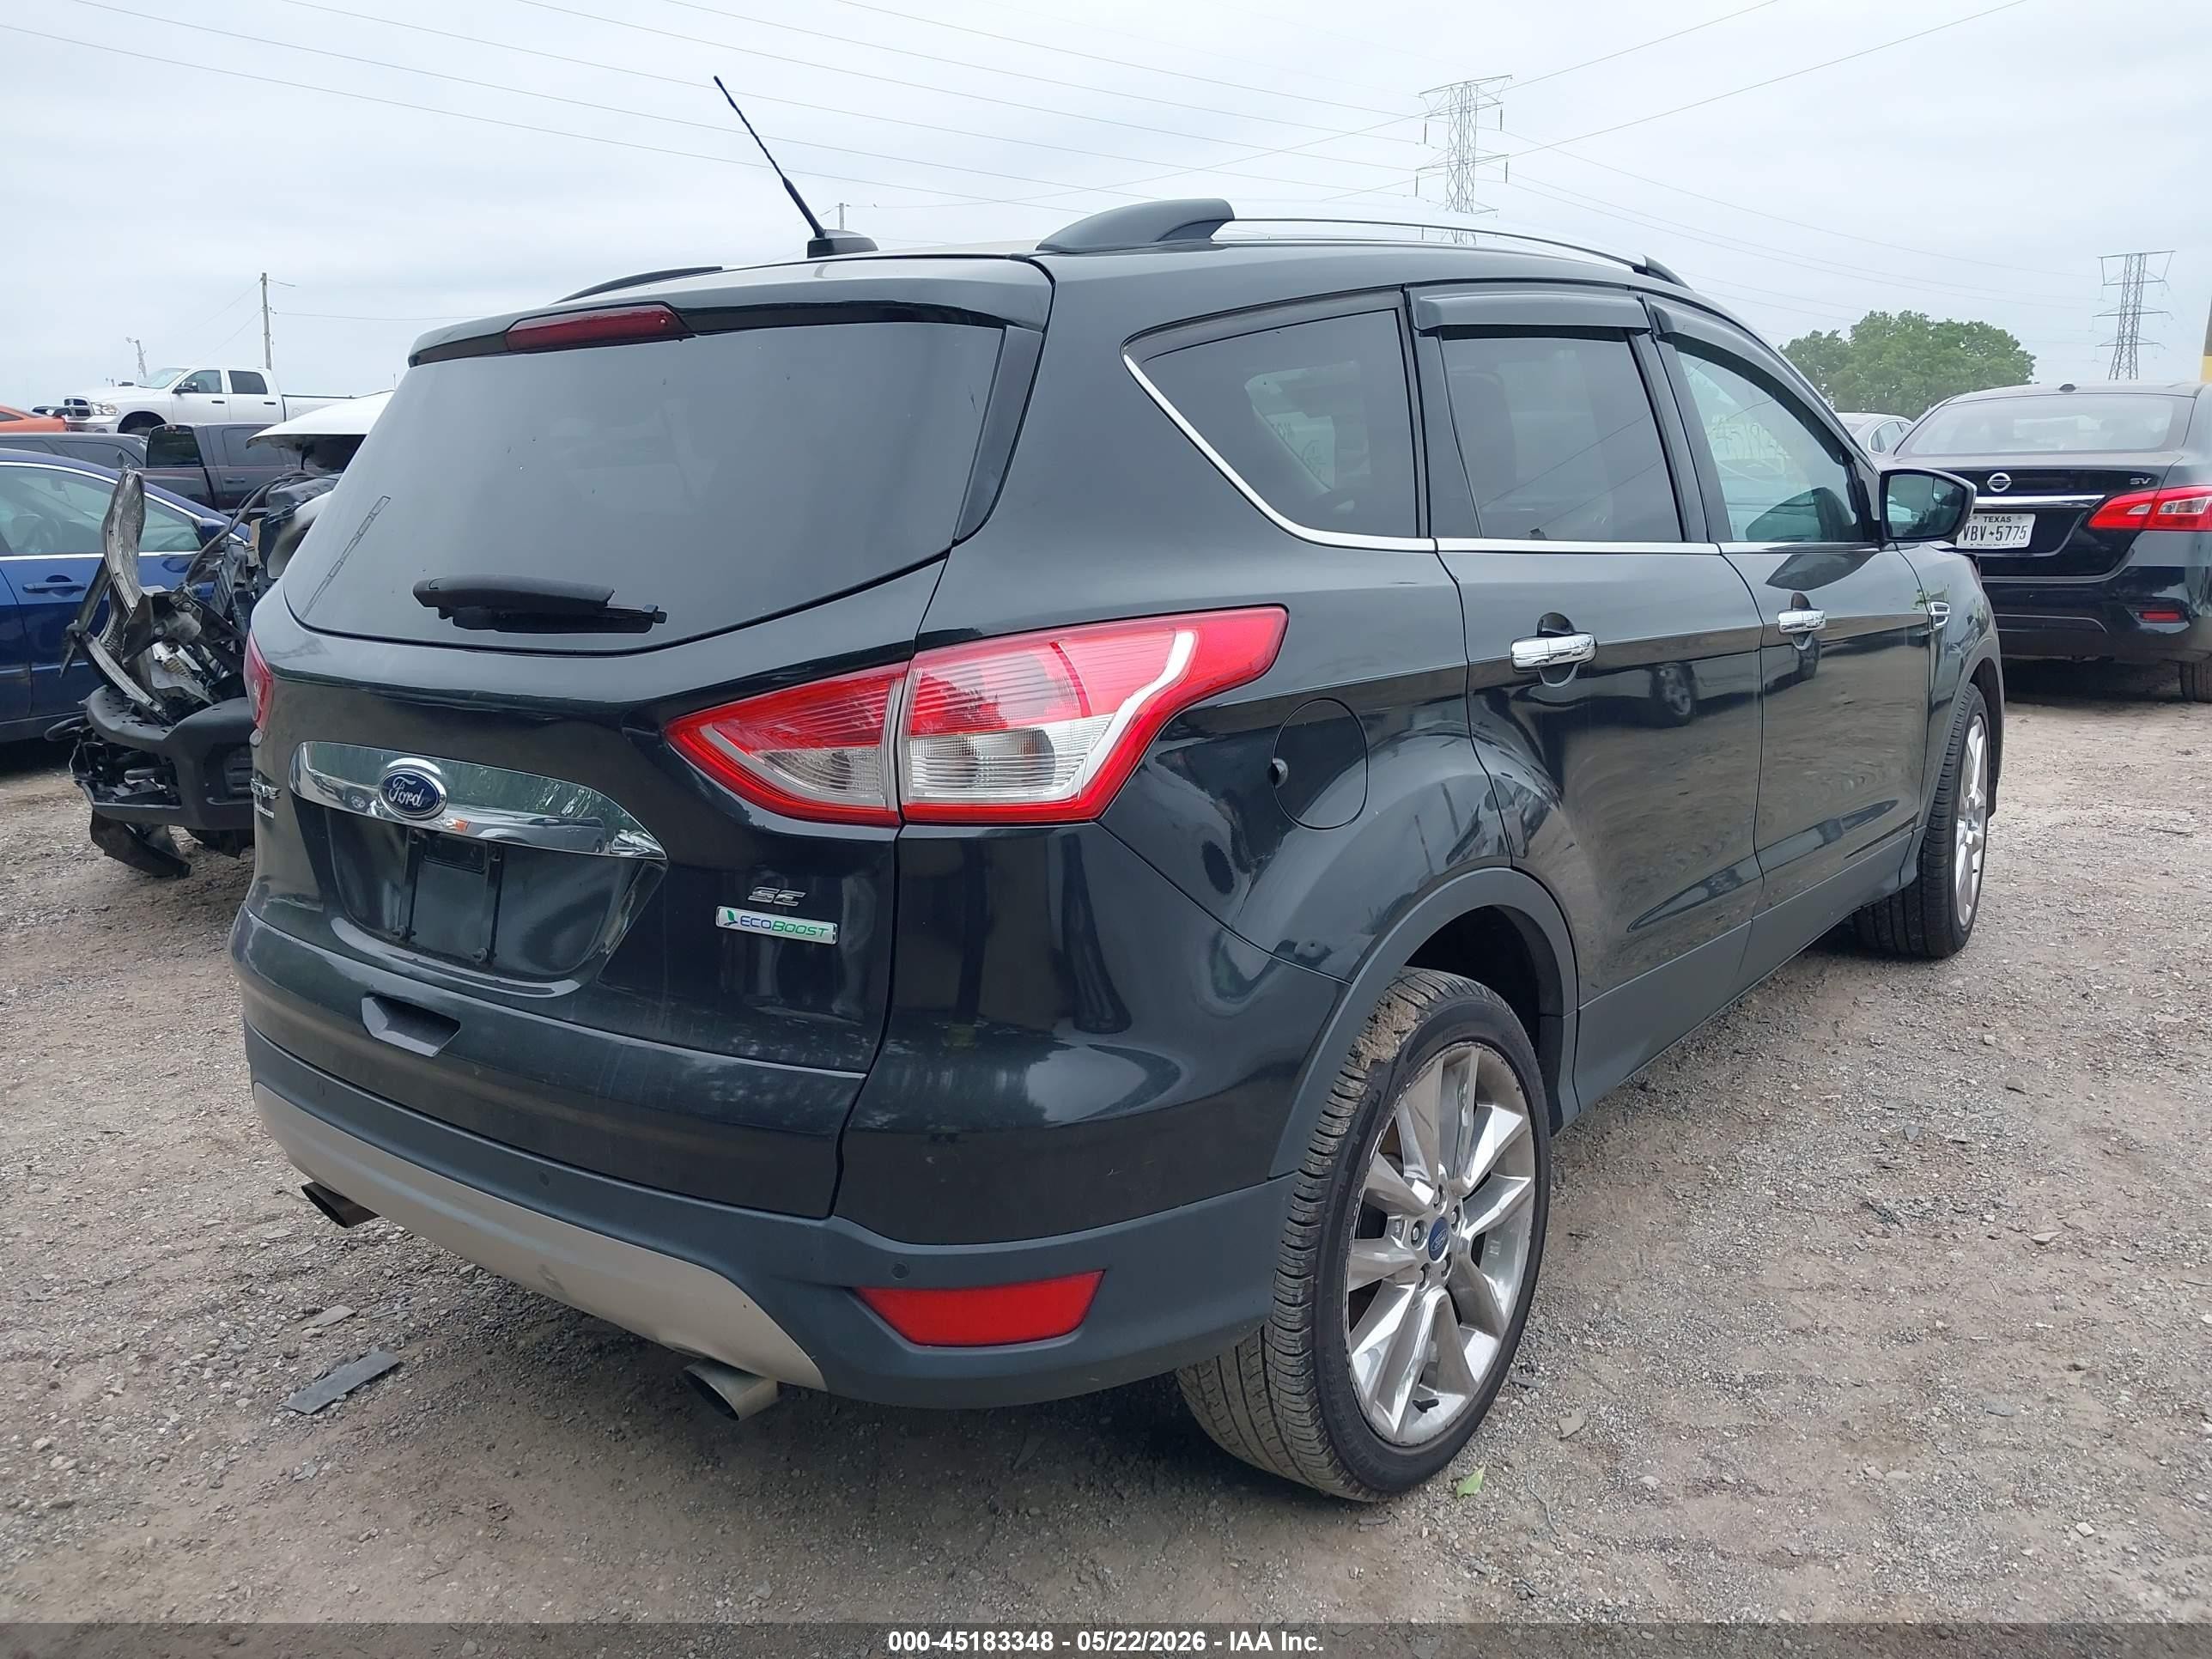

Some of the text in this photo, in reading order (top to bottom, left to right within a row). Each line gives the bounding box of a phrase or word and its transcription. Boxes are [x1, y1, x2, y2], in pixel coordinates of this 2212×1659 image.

[388, 775, 425, 808] Ford
[747, 885, 806, 907] SE
[739, 915, 830, 938] ECOBOOST
